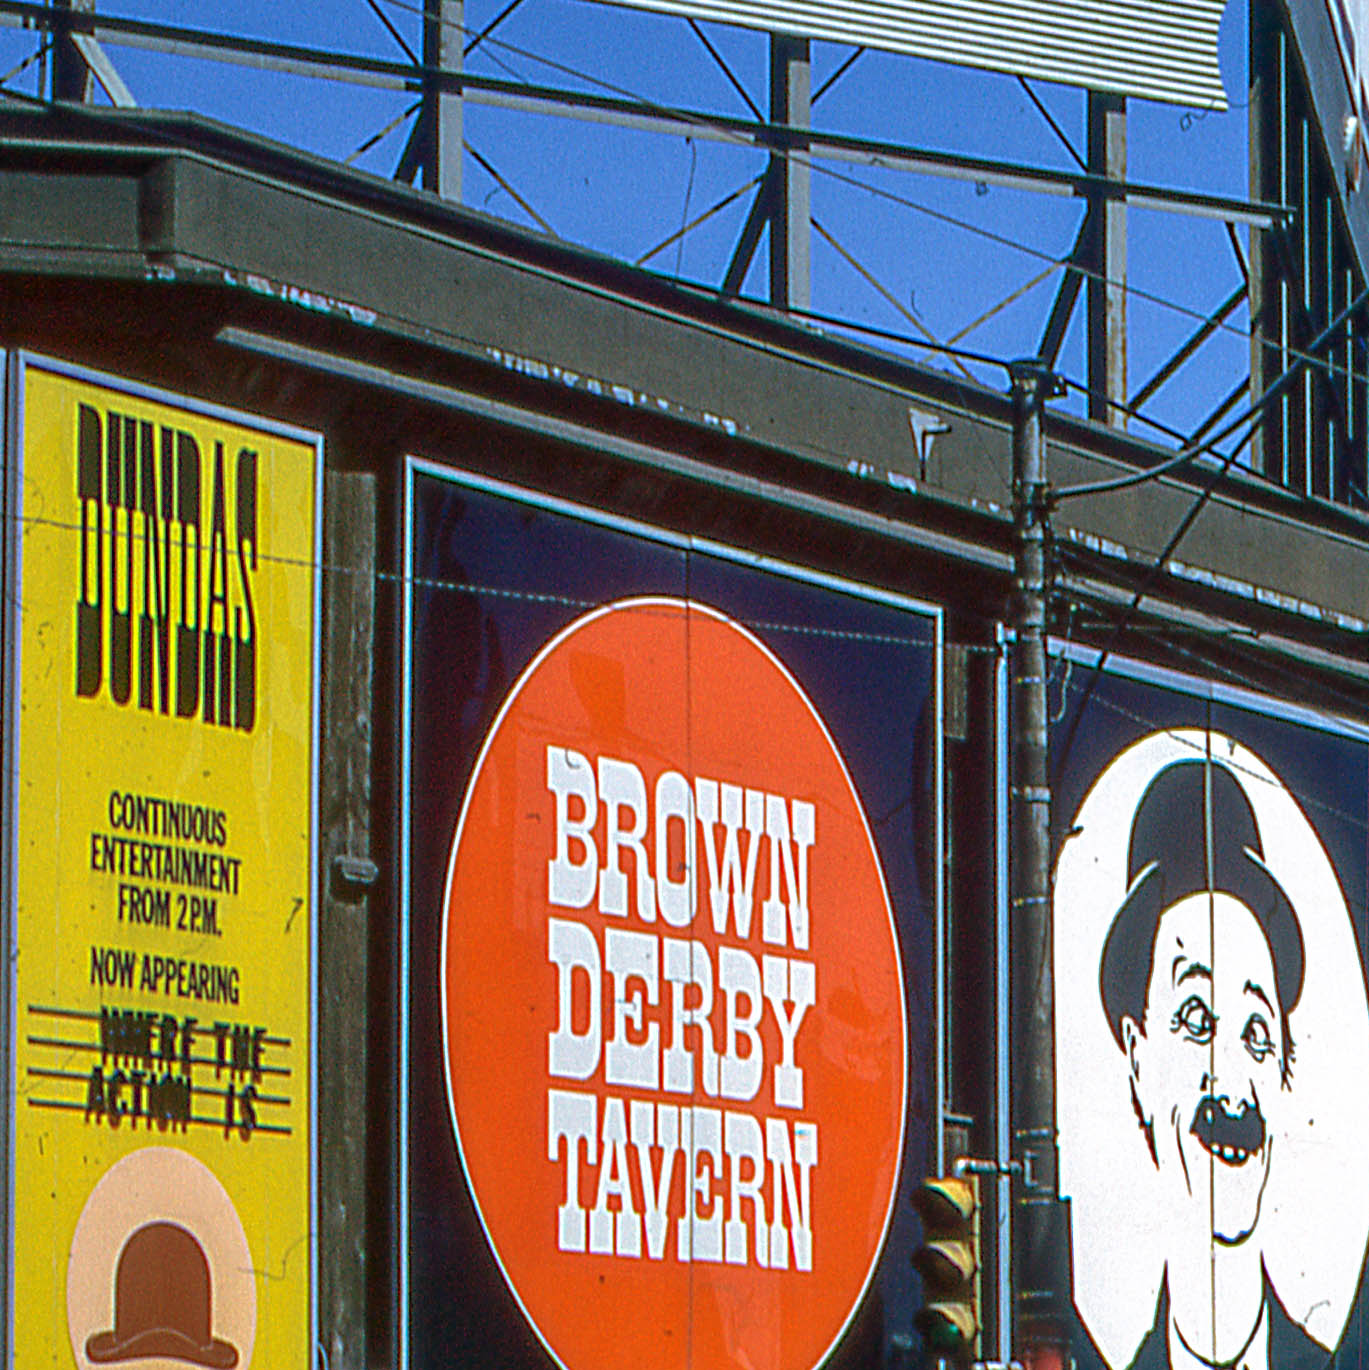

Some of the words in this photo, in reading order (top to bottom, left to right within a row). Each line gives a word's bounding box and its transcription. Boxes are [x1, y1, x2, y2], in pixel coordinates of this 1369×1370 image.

[75, 402, 258, 734] DUNDAS
[109, 791, 227, 847] CONTINUOUS
[547, 745, 815, 951] BROWN
[91, 834, 241, 895] ENTERTAINMENT
[118, 884, 171, 928] FROM
[91, 947, 136, 989] NOW
[140, 954, 239, 1005] APPEARING
[548, 917, 816, 1109] DERBY
[101, 1005, 198, 1077] WHERE
[214, 1020, 267, 1084] THE
[548, 1089, 817, 1272] TAVERN
